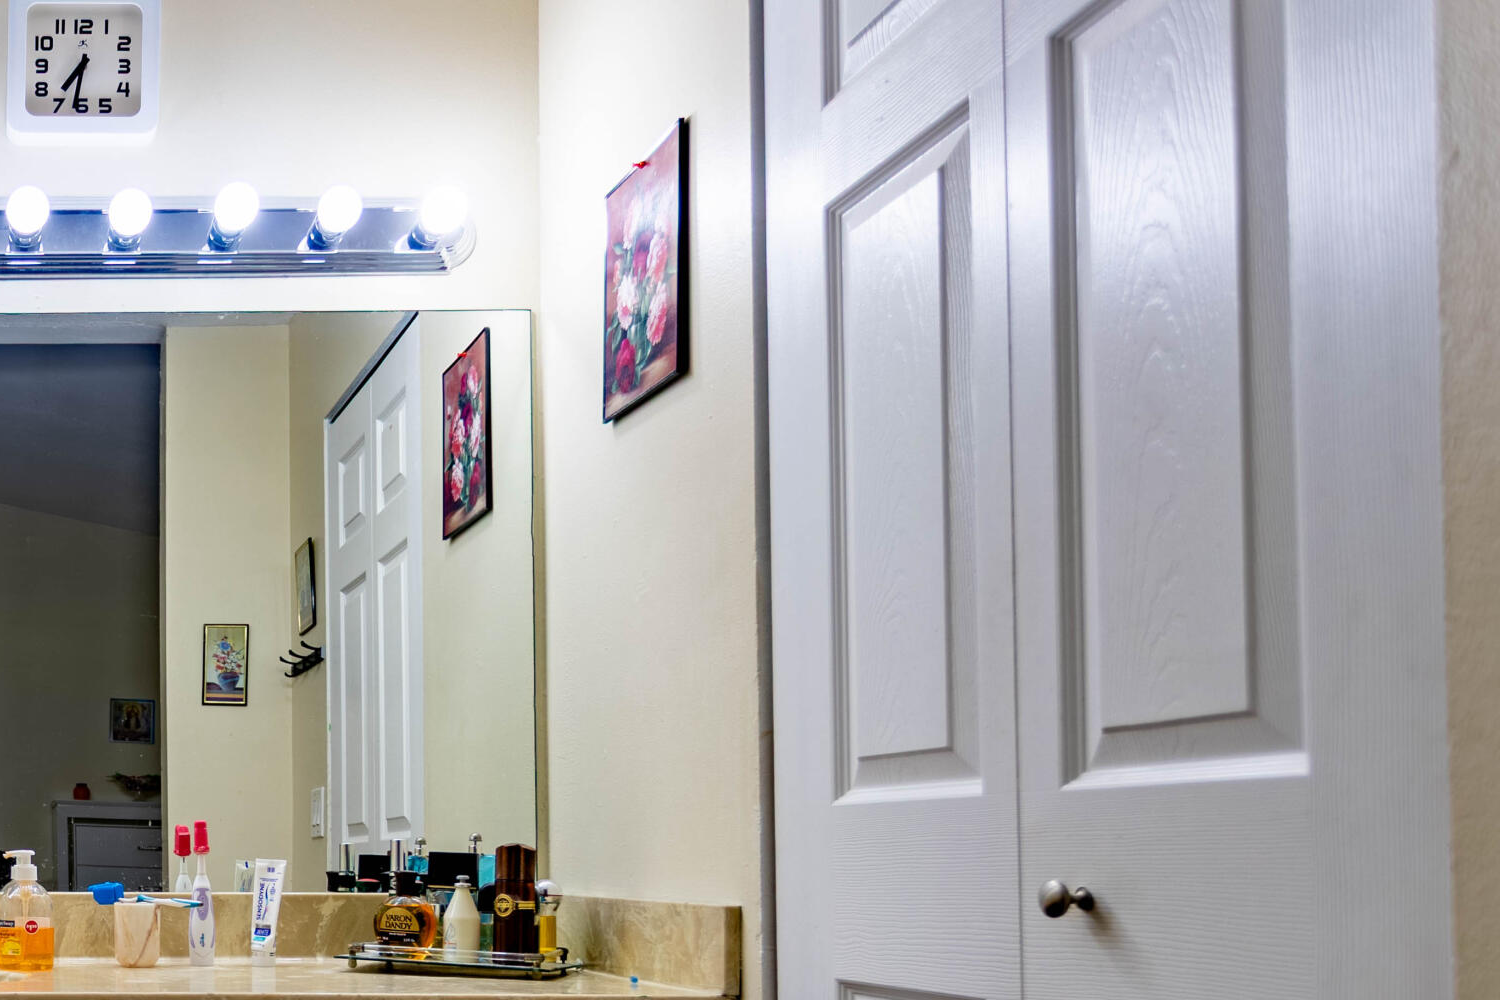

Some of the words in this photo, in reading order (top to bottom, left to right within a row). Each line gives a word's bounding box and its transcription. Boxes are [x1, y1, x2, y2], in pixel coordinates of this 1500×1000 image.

[55, 19, 66, 35] 11
[74, 19, 94, 35] 12
[35, 36, 54, 51] 10
[117, 36, 132, 51] 2
[35, 59, 49, 74] 9
[118, 59, 131, 74] 3
[35, 82, 49, 97] 8
[116, 82, 130, 98] 4
[53, 98, 66, 114] 7
[75, 98, 89, 114] 6
[99, 98, 112, 114] 5
[256, 882, 265, 921] SENSODYNE
[385, 920, 413, 930] DANDY
